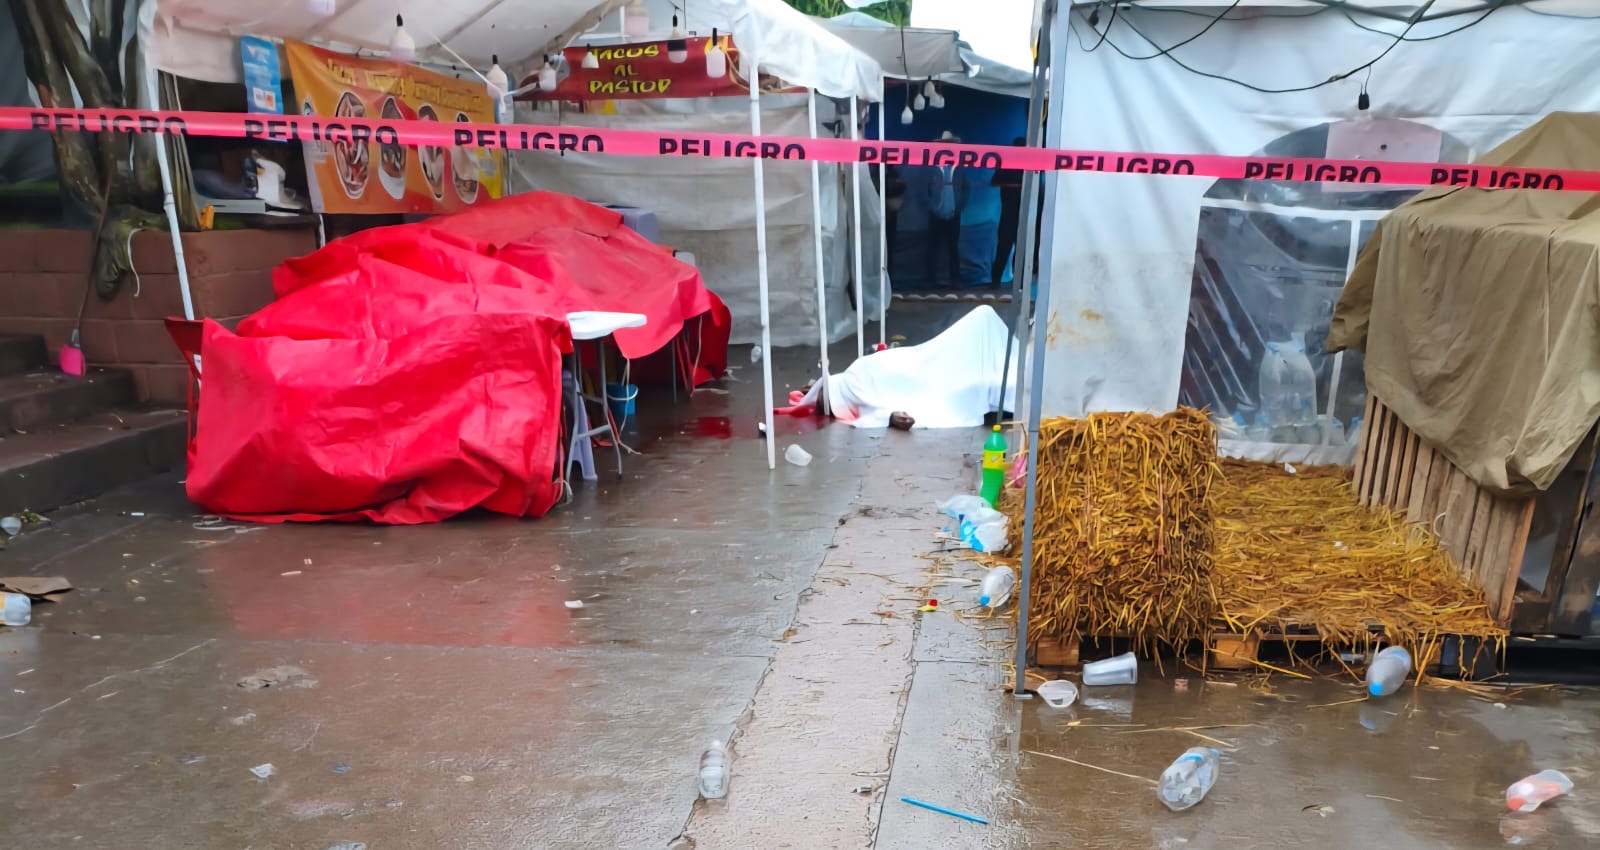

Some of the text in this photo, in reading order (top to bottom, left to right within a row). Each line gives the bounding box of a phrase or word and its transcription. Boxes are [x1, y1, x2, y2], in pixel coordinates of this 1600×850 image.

[614, 63, 639, 77] AL
[31, 112, 1564, 190] PELIGRO PELIGRO PELIGRO PELIGRO PELIGRO PELIGRO PELIGRO PELIGRO
